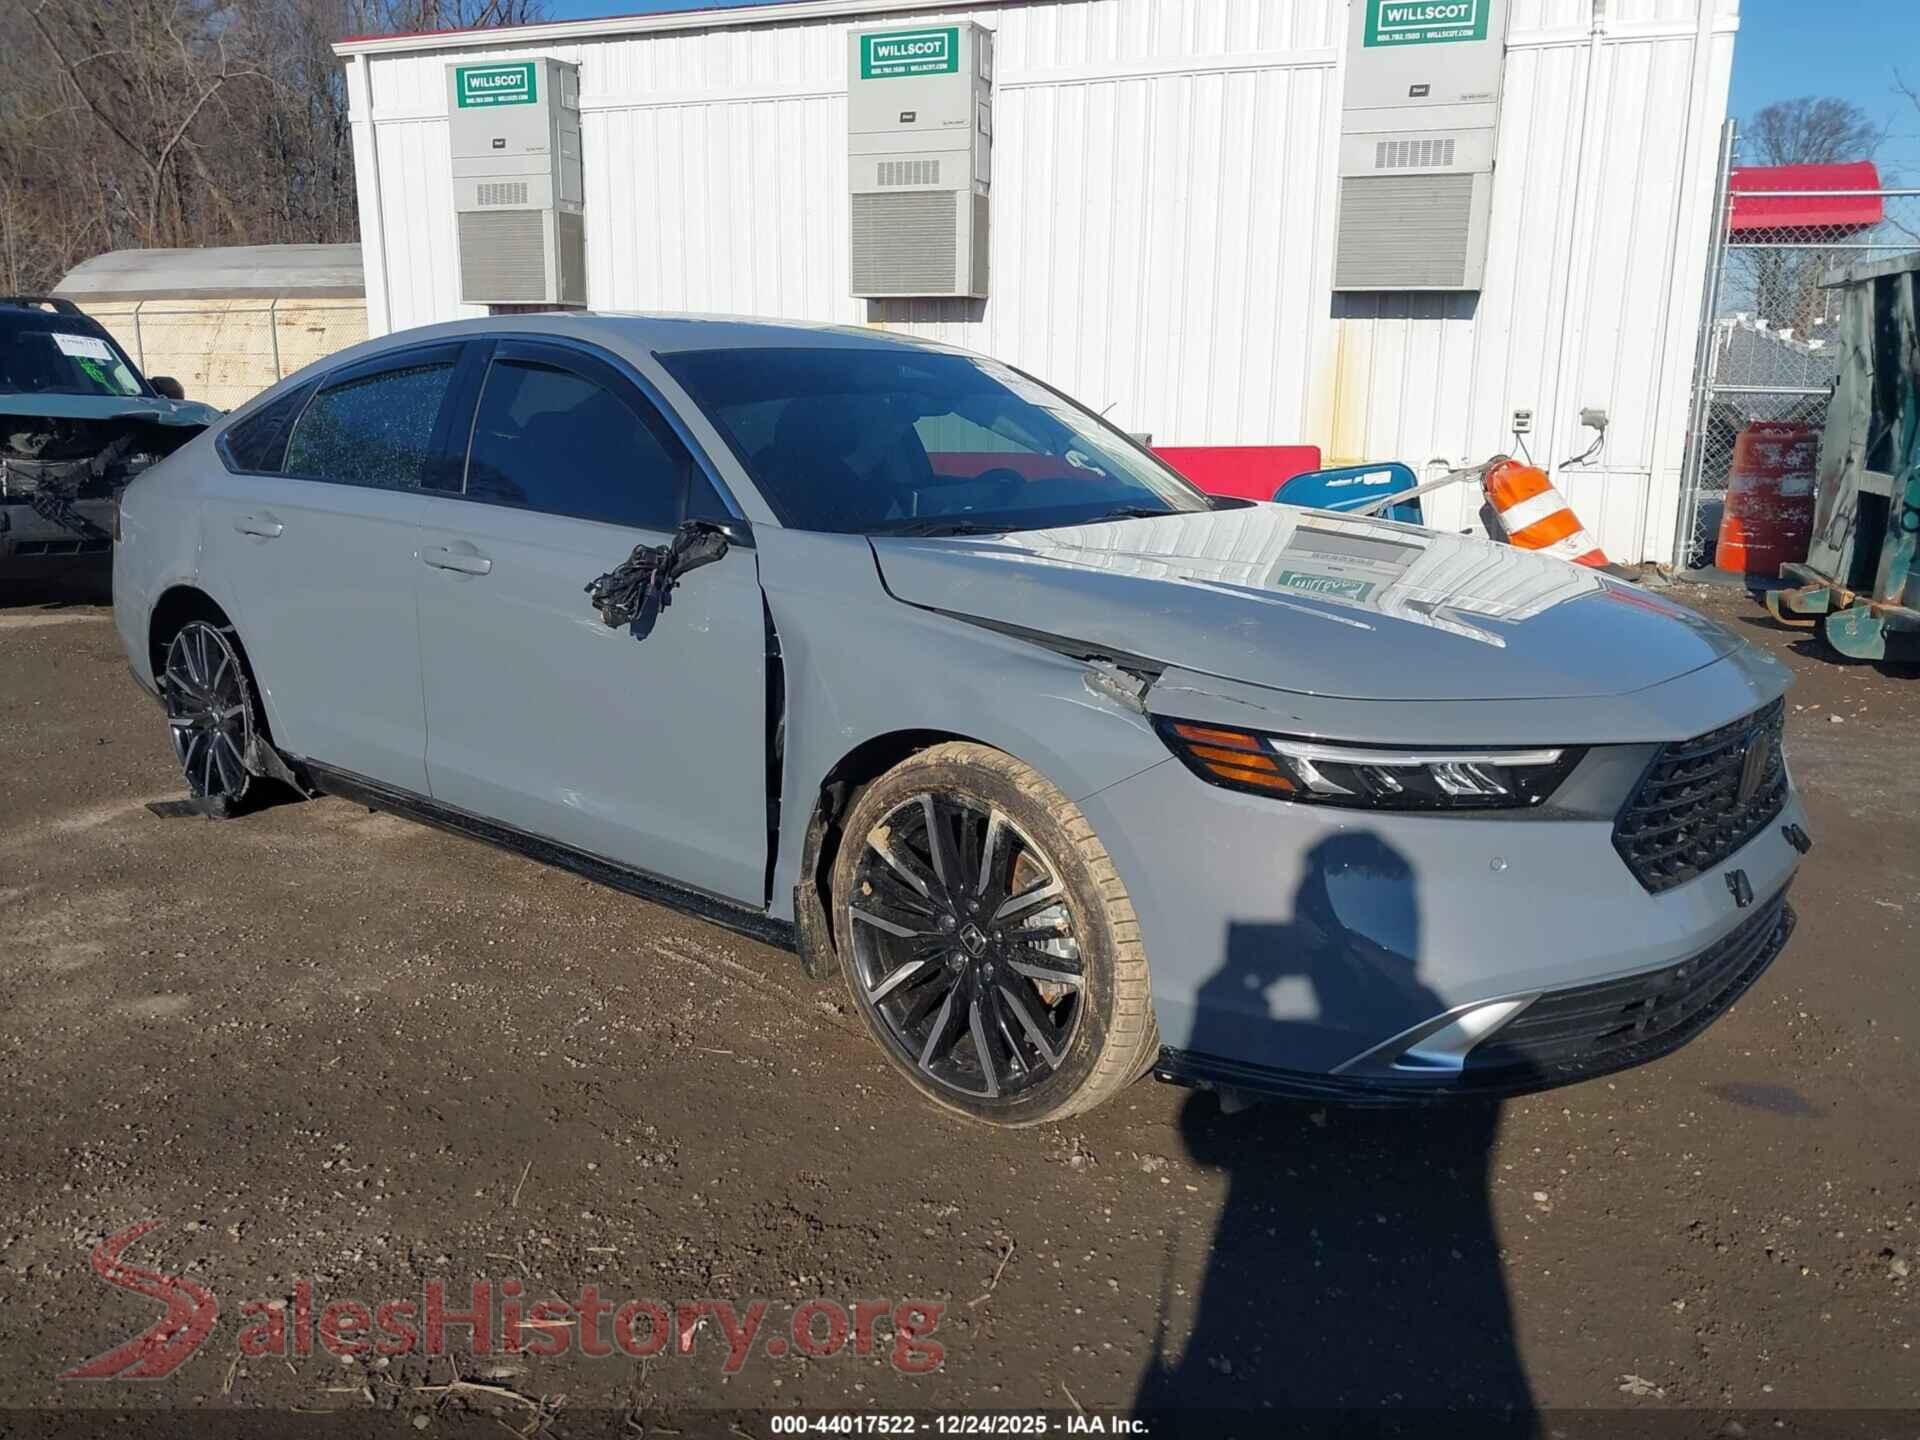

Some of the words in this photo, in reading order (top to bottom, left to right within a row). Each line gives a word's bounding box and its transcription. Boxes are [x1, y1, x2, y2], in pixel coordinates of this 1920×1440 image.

[1387, 4, 1469, 21] WILLSCOT
[877, 41, 942, 57] WILLSCOT
[470, 74, 523, 88] WILLSCOT
